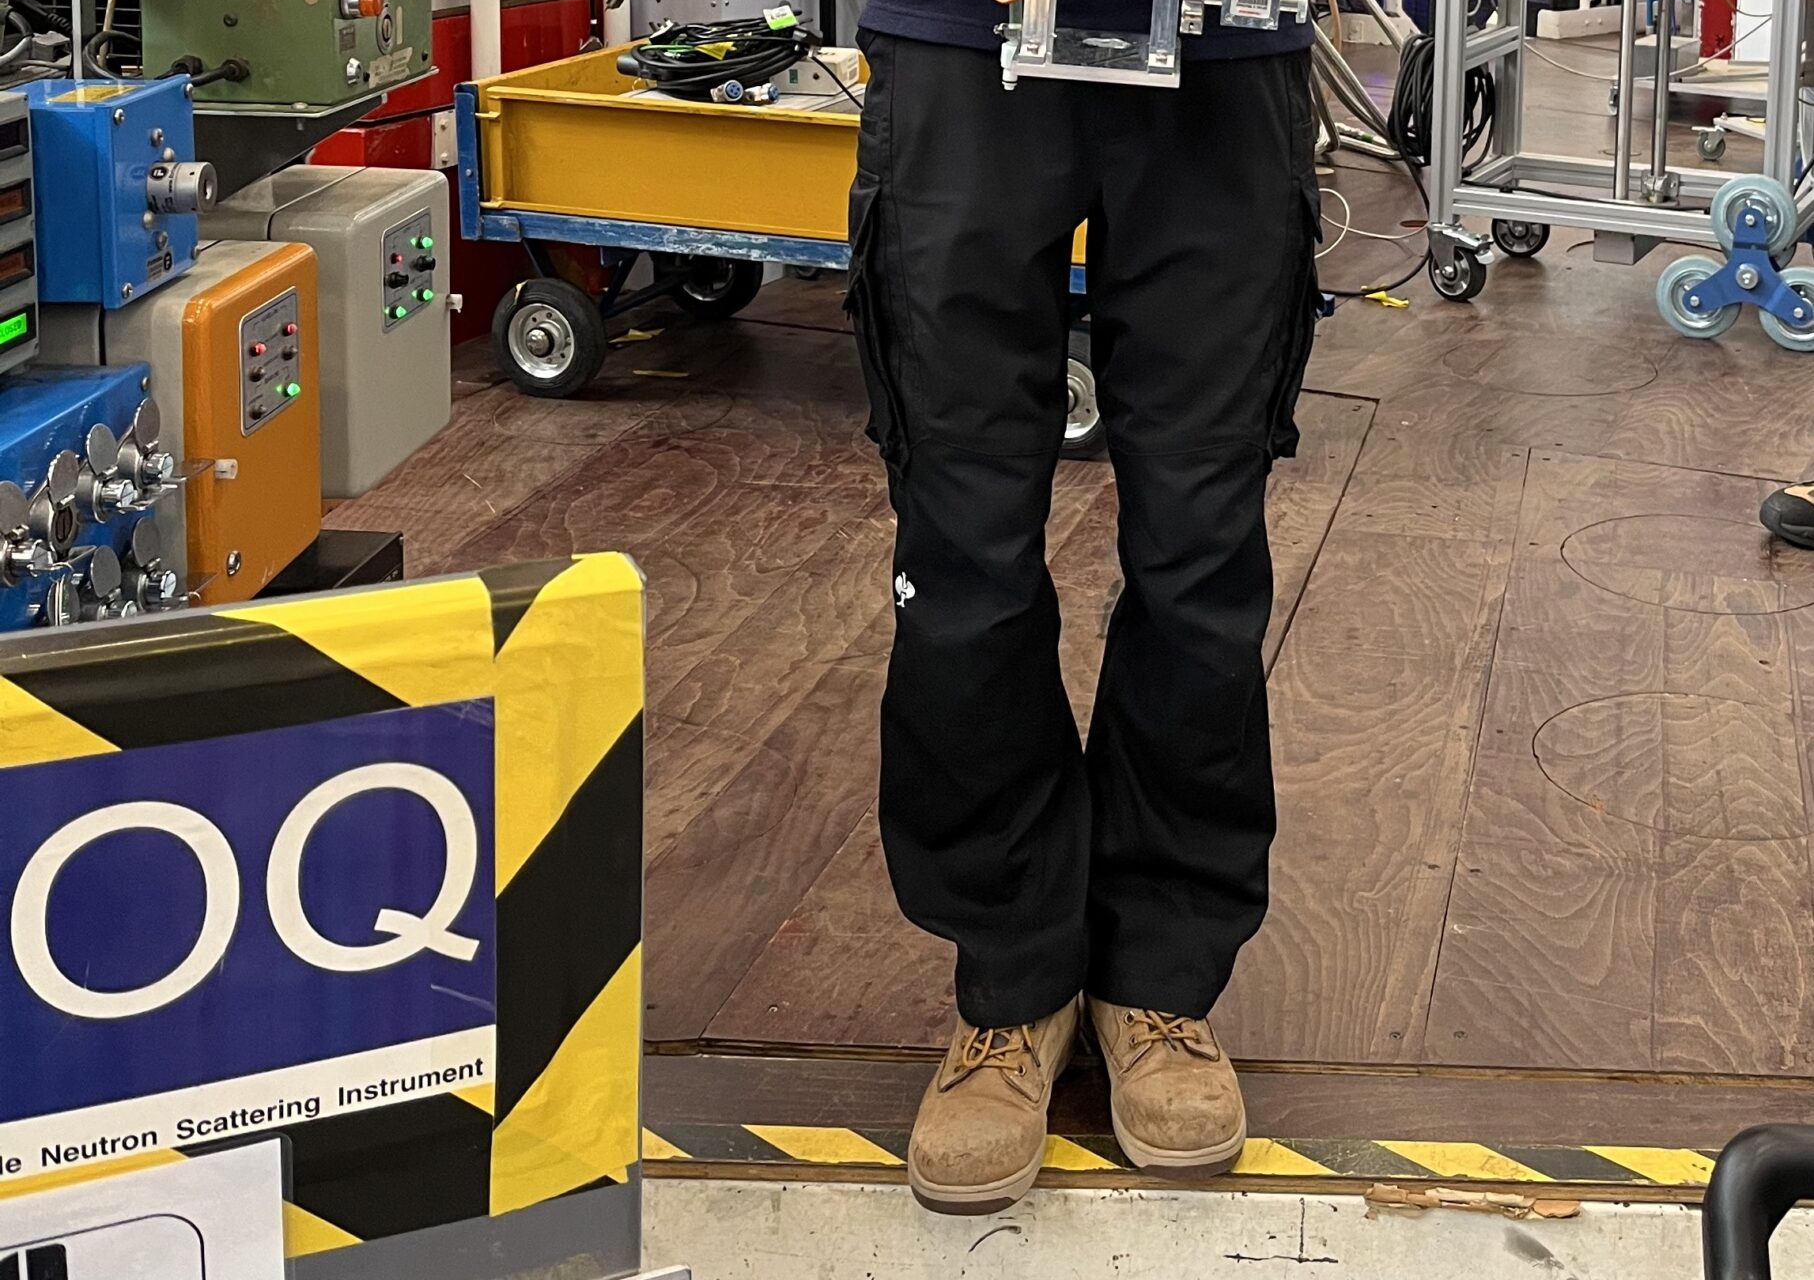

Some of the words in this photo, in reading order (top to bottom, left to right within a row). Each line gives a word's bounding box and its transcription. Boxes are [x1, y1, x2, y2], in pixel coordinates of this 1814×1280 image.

[41, 1130, 158, 1167] Neutron
[176, 1096, 320, 1140] Scattering
[338, 1057, 484, 1106] Instrument
